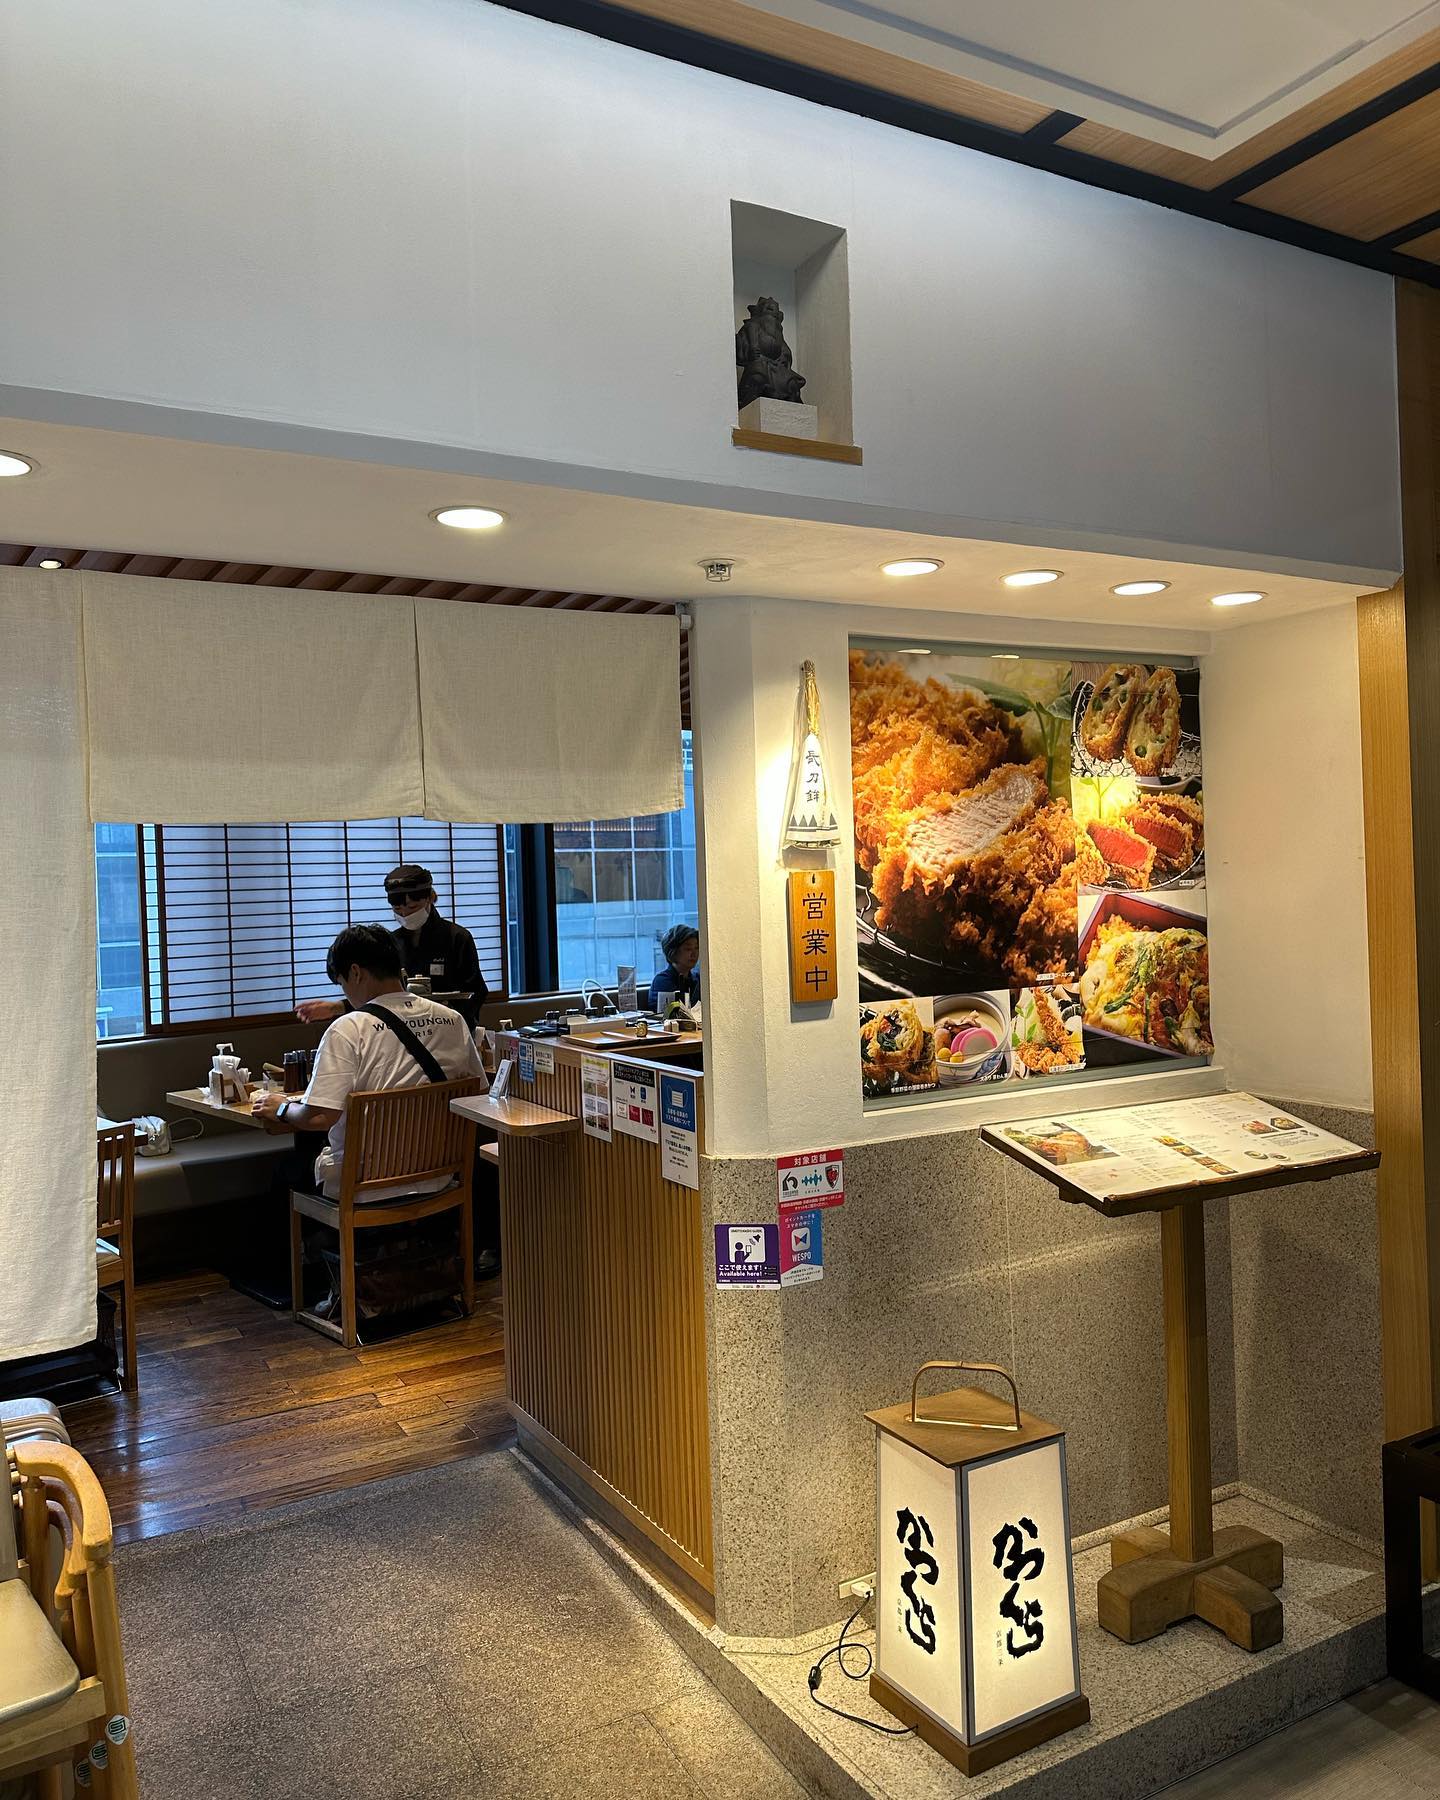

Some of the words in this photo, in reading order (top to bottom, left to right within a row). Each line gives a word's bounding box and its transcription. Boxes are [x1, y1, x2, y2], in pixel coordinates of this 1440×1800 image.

[801, 891, 830, 994] 営業中
[372, 1017, 455, 1032] WOUNGMI
[415, 1028, 433, 1038] RIS
[793, 1153, 827, 1167] 対象店舗
[791, 1251, 812, 1263] WESPO
